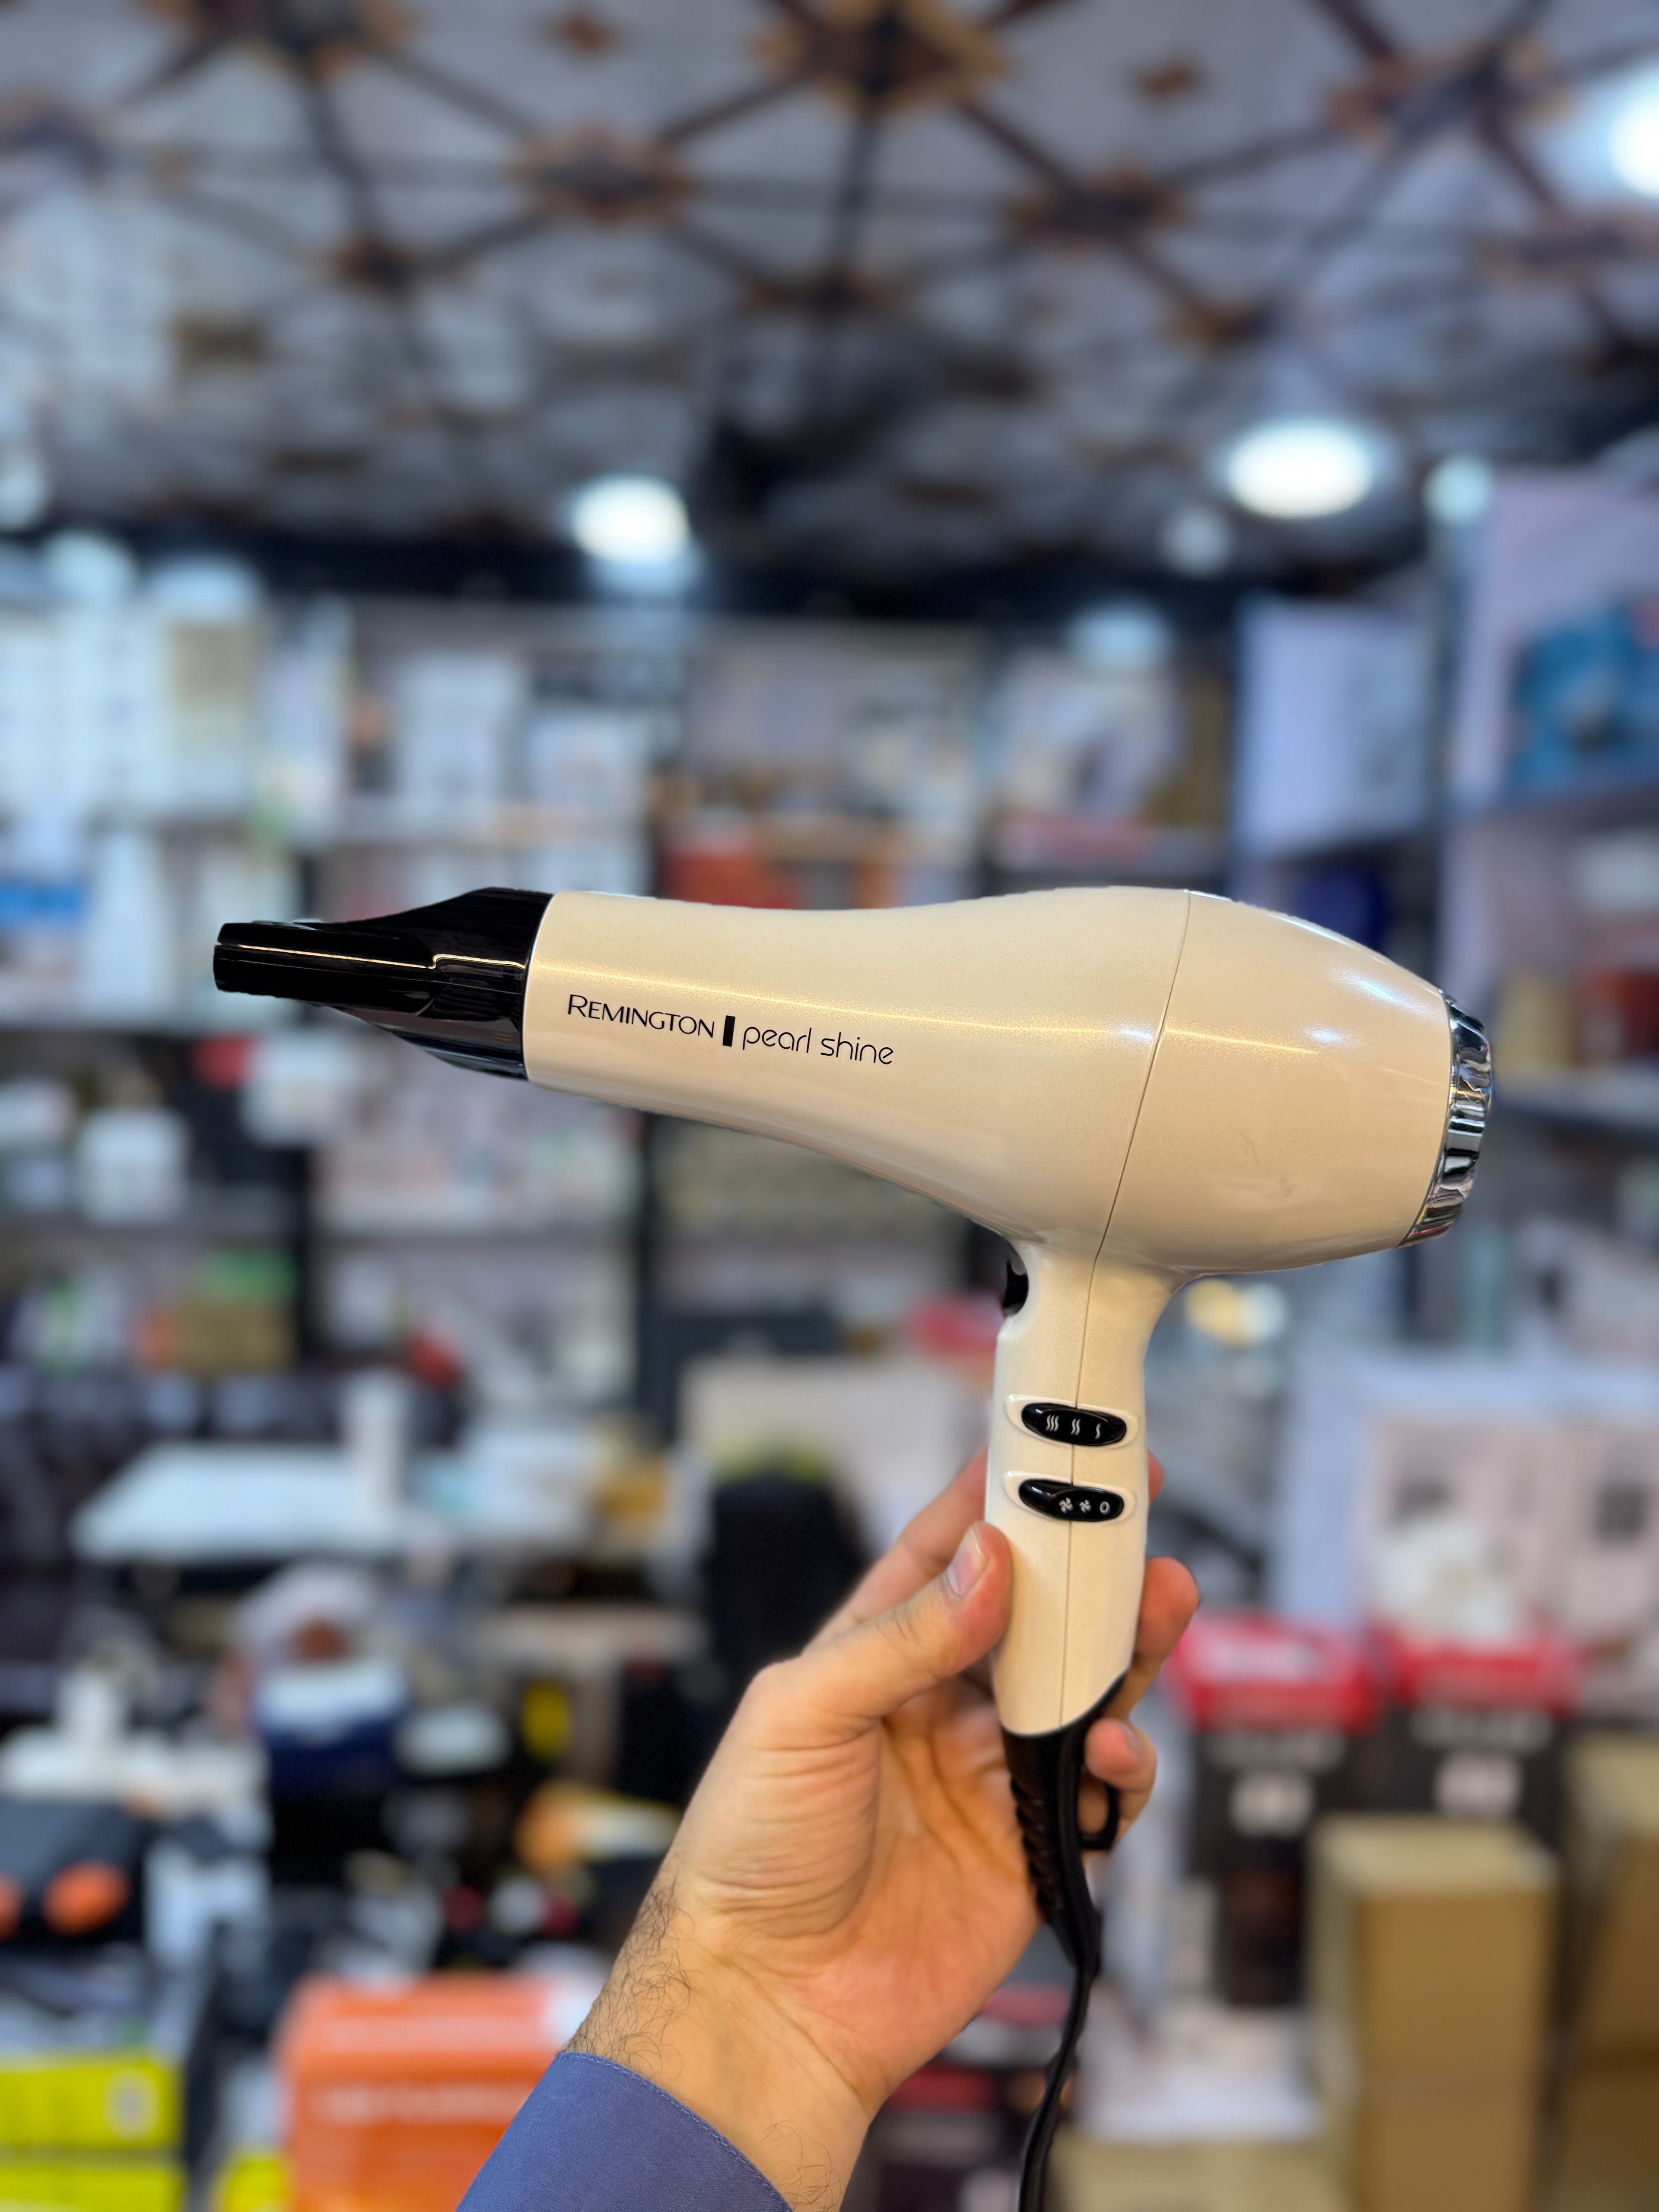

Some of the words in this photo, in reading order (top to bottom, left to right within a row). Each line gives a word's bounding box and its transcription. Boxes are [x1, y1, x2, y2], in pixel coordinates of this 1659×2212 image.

[567, 994, 715, 1039] REMINGTON
[742, 1027, 812, 1054] pearl
[820, 1031, 894, 1065] shine
